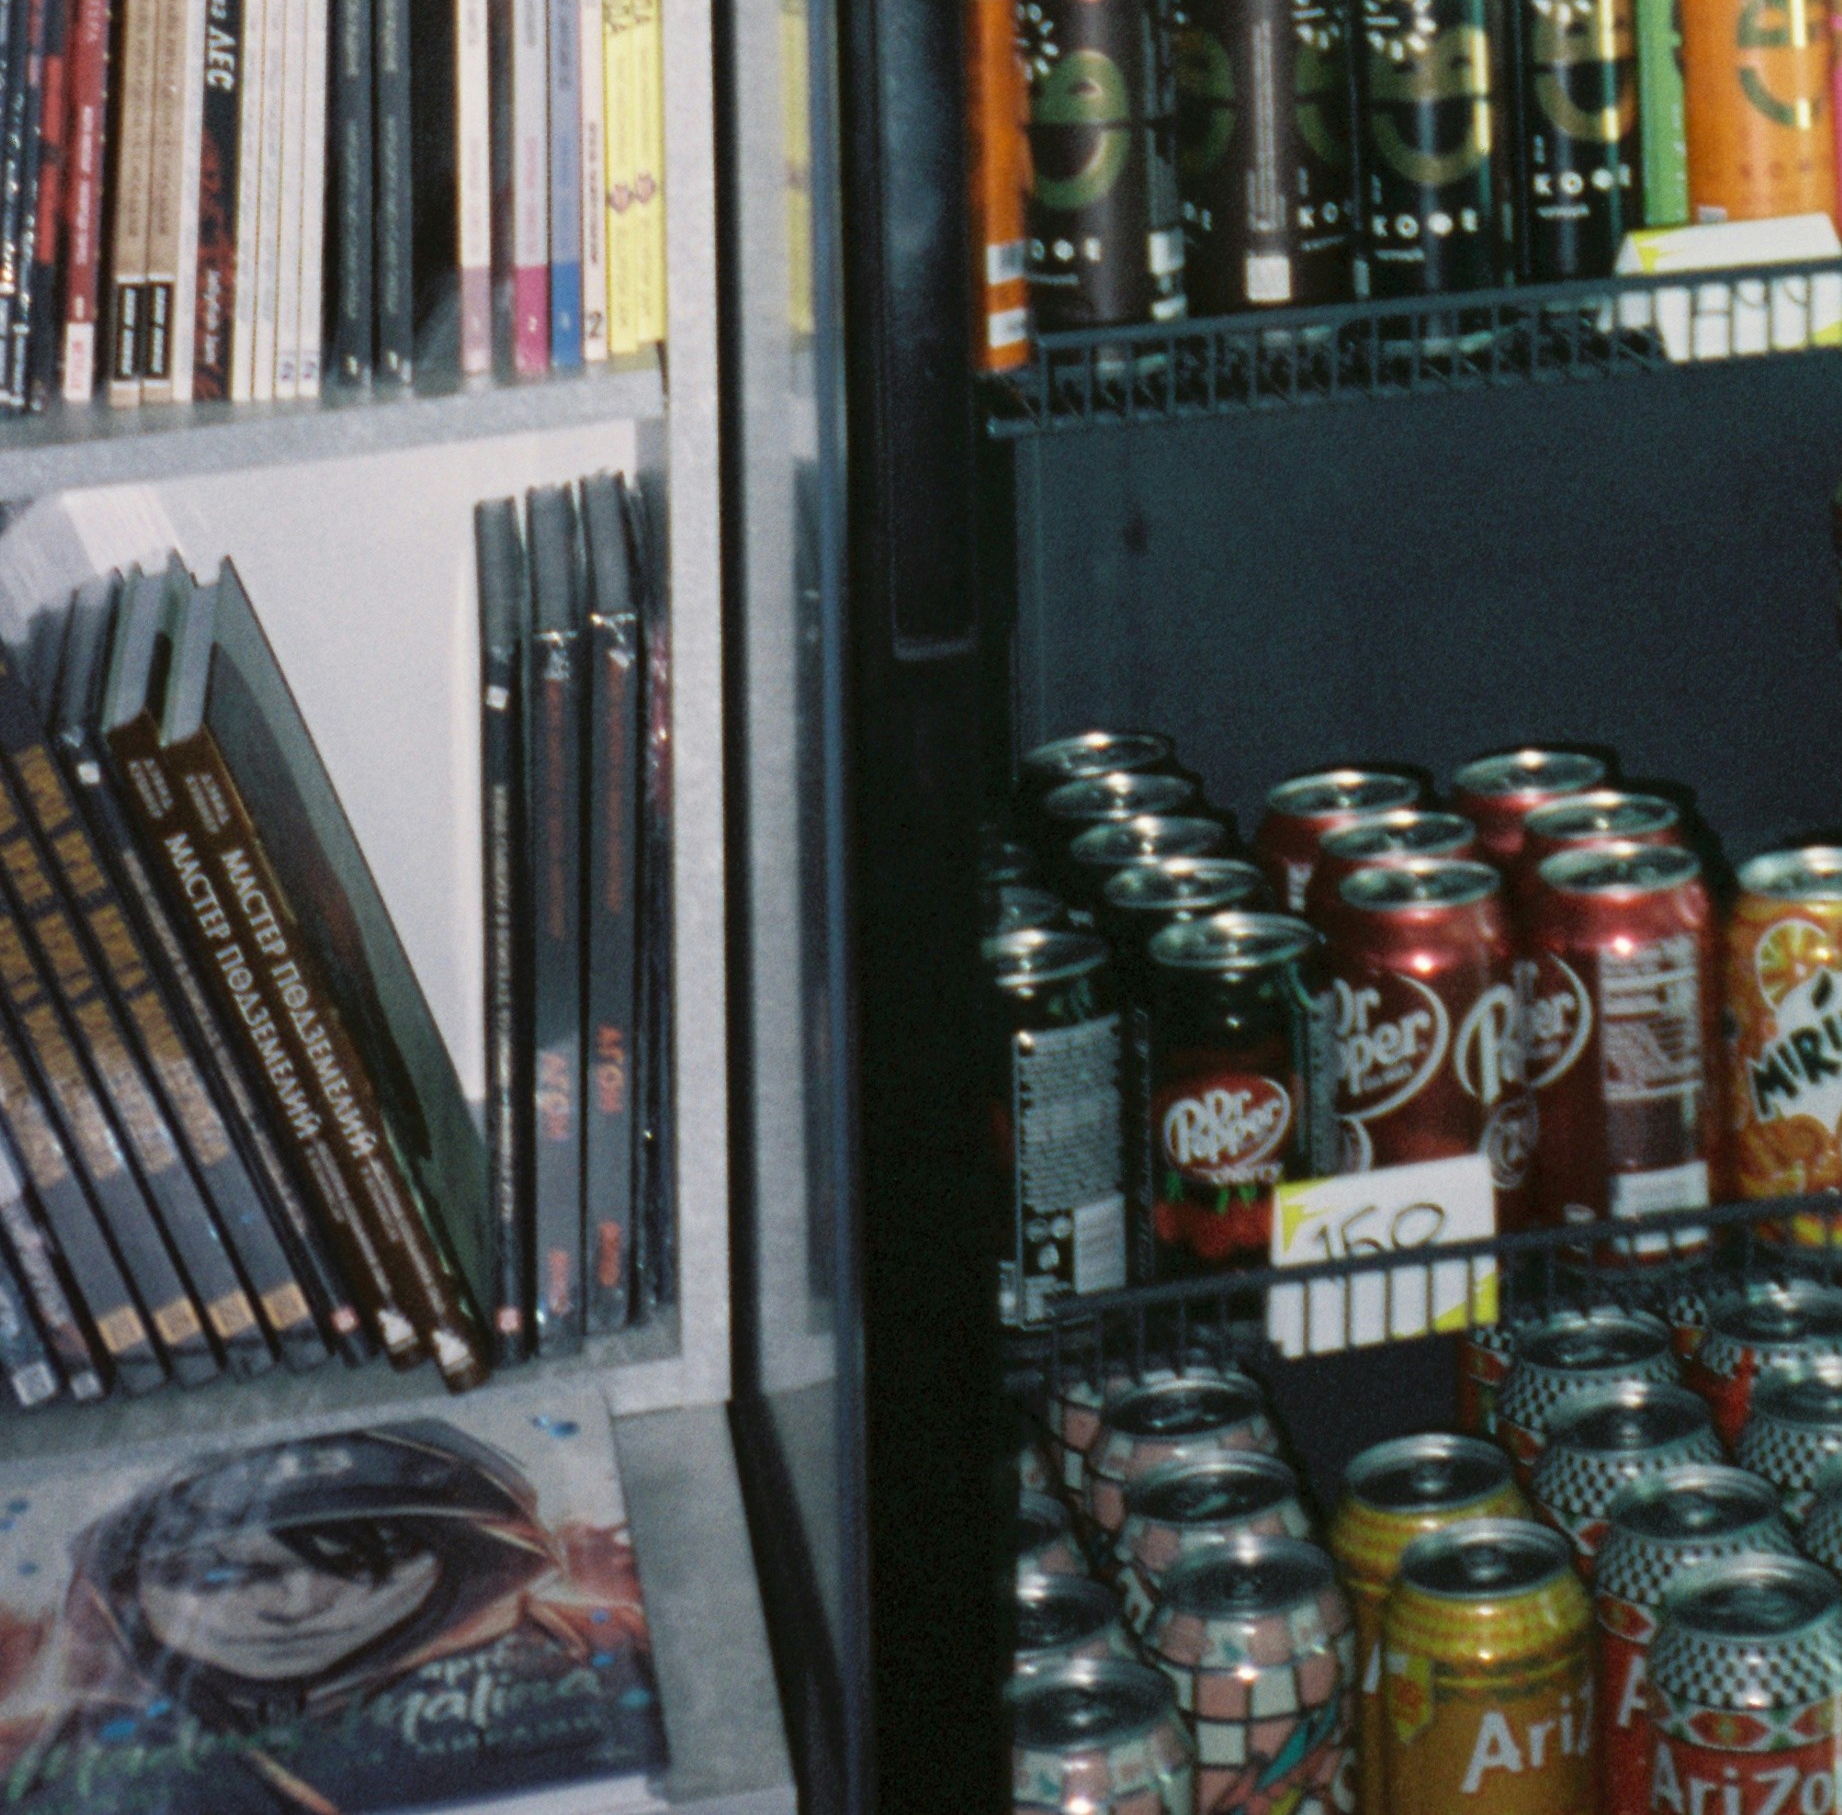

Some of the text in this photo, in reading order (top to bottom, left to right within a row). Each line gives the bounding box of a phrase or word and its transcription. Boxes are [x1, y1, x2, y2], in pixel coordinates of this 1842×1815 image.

[205, 24, 237, 91] ЛЕС
[164, 831, 233, 951] МАСТЕР
[216, 941, 320, 1141] ПОДЗЕМЕЛИЙ
[220, 848, 377, 1161] МАСТЕР ПОДЗЕМЕЛИЙ
[1168, 1098, 1284, 1168] Pepper
[1205, 1090, 1252, 1133] Dr
